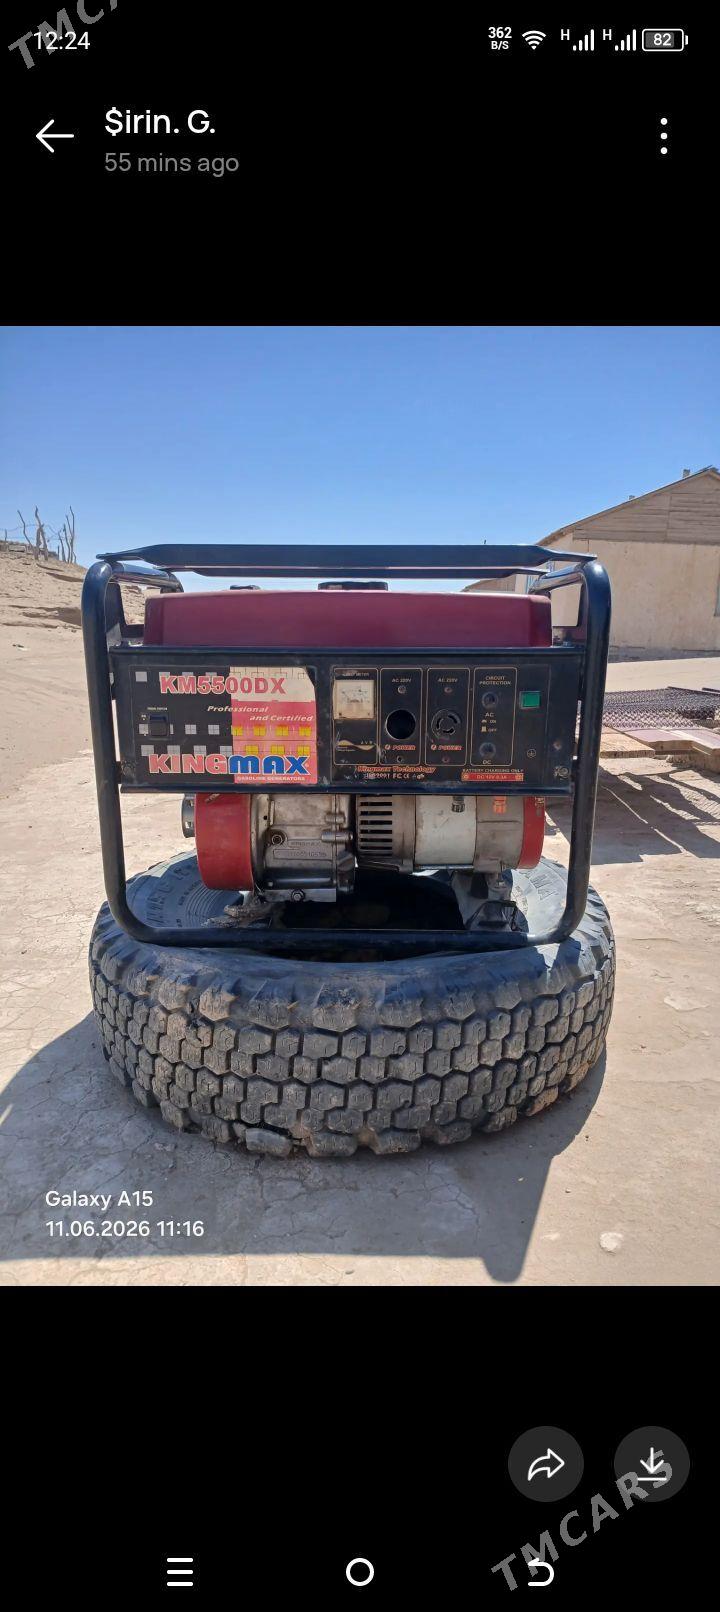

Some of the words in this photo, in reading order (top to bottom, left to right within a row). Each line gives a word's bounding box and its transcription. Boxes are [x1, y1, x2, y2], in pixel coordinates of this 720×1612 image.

[488, 27, 512, 39] 362
[561, 29, 570, 40] H
[603, 29, 612, 40] H
[33, 32, 91, 50] 12:24
[491, 41, 510, 50] B/S
[654, 33, 672, 46] 82
[105, 107, 180, 136] $irin.
[188, 110, 216, 134] G.
[105, 153, 132, 172] 55
[138, 153, 191, 172] mins
[198, 158, 240, 178] ago
[159, 675, 286, 695] KM5500DX
[207, 705, 269, 713] Professional
[249, 714, 268, 722] and
[270, 714, 313, 722] Certified
